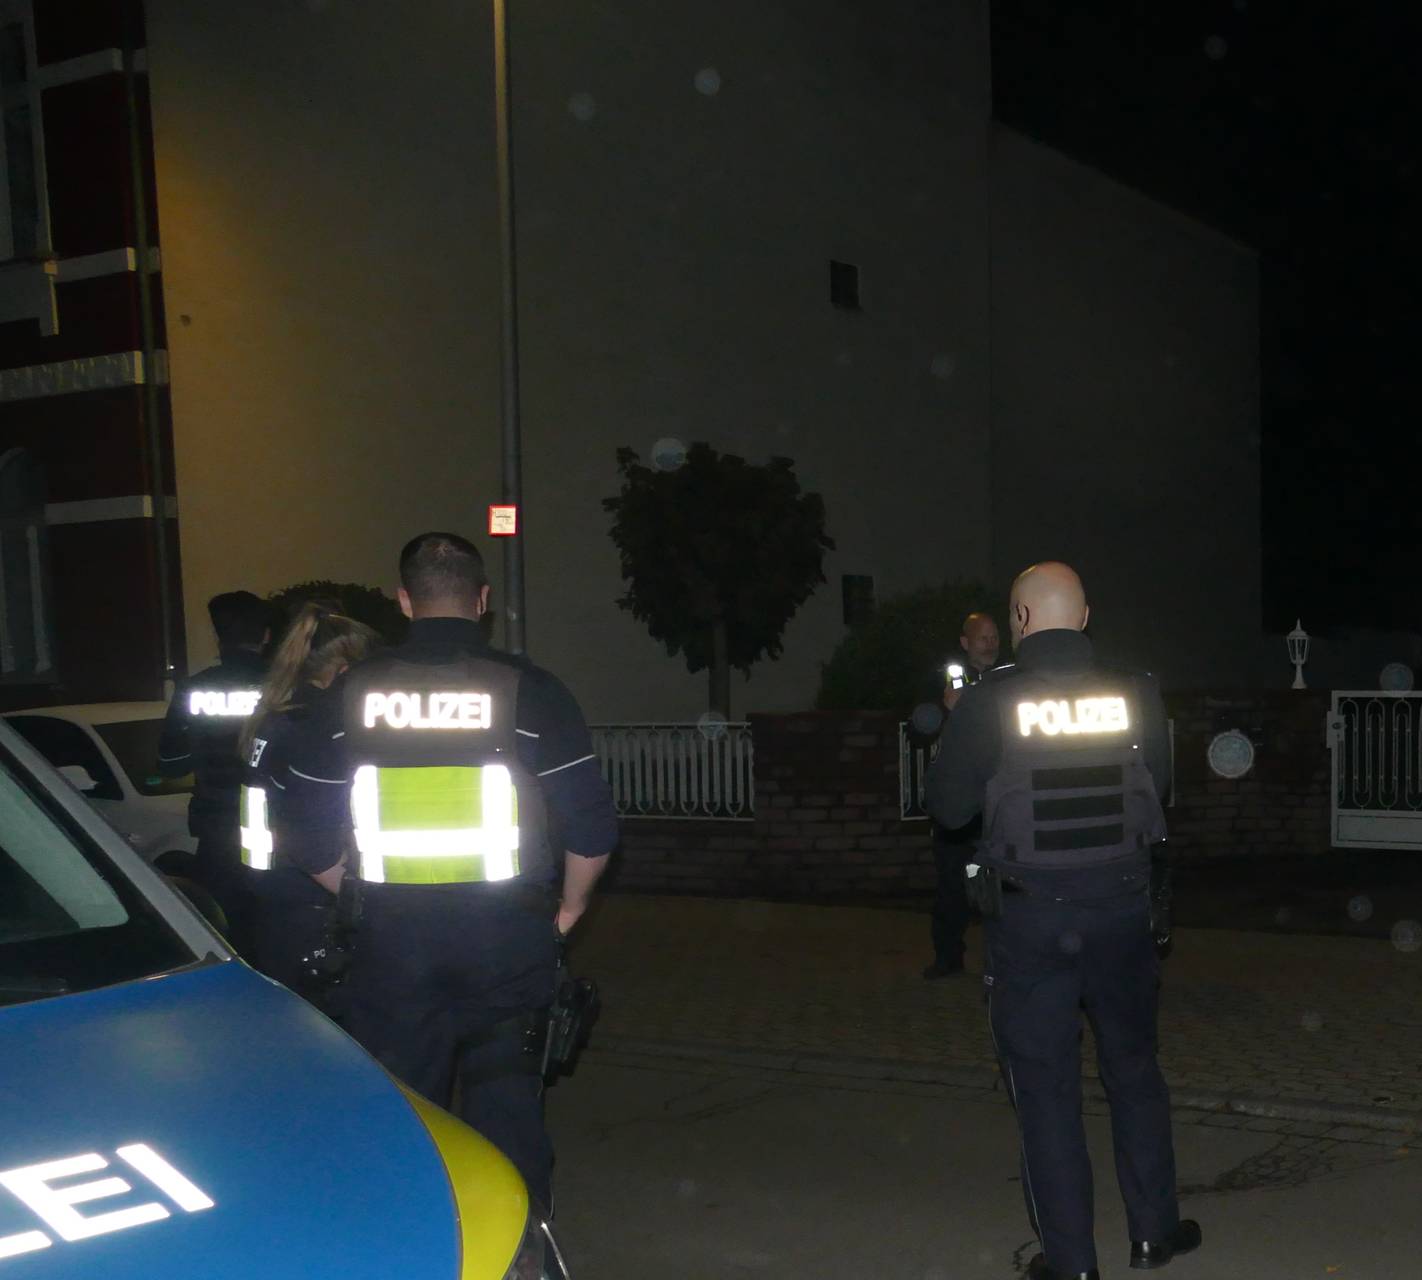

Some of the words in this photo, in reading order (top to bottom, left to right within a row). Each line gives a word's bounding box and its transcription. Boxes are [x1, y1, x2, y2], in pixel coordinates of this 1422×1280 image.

[190, 691, 262, 715] POLIZE
[364, 692, 492, 728] POLIZEI
[1017, 697, 1128, 736] POLIZEI
